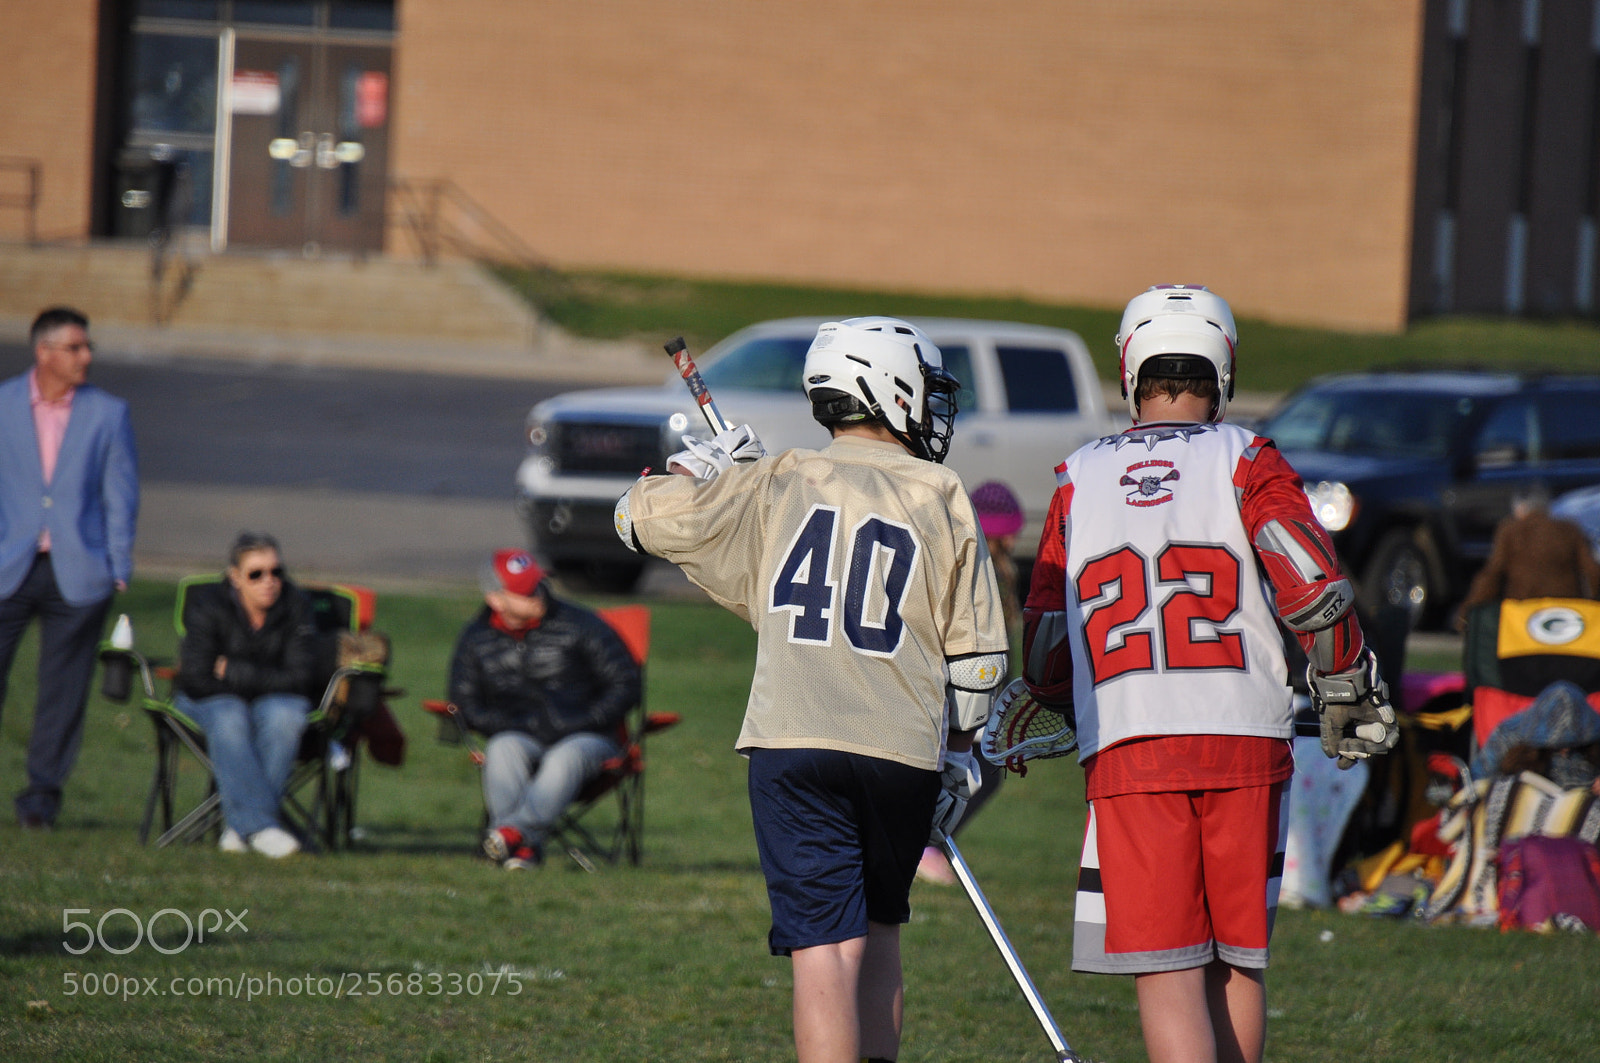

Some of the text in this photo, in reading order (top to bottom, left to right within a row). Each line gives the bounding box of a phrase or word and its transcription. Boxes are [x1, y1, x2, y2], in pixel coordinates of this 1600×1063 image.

[1126, 460, 1175, 474] BULLDOGS
[1126, 492, 1174, 507] LACROSSE
[768, 503, 922, 659] 40
[1072, 541, 1251, 691] 22
[1322, 592, 1346, 622] STX
